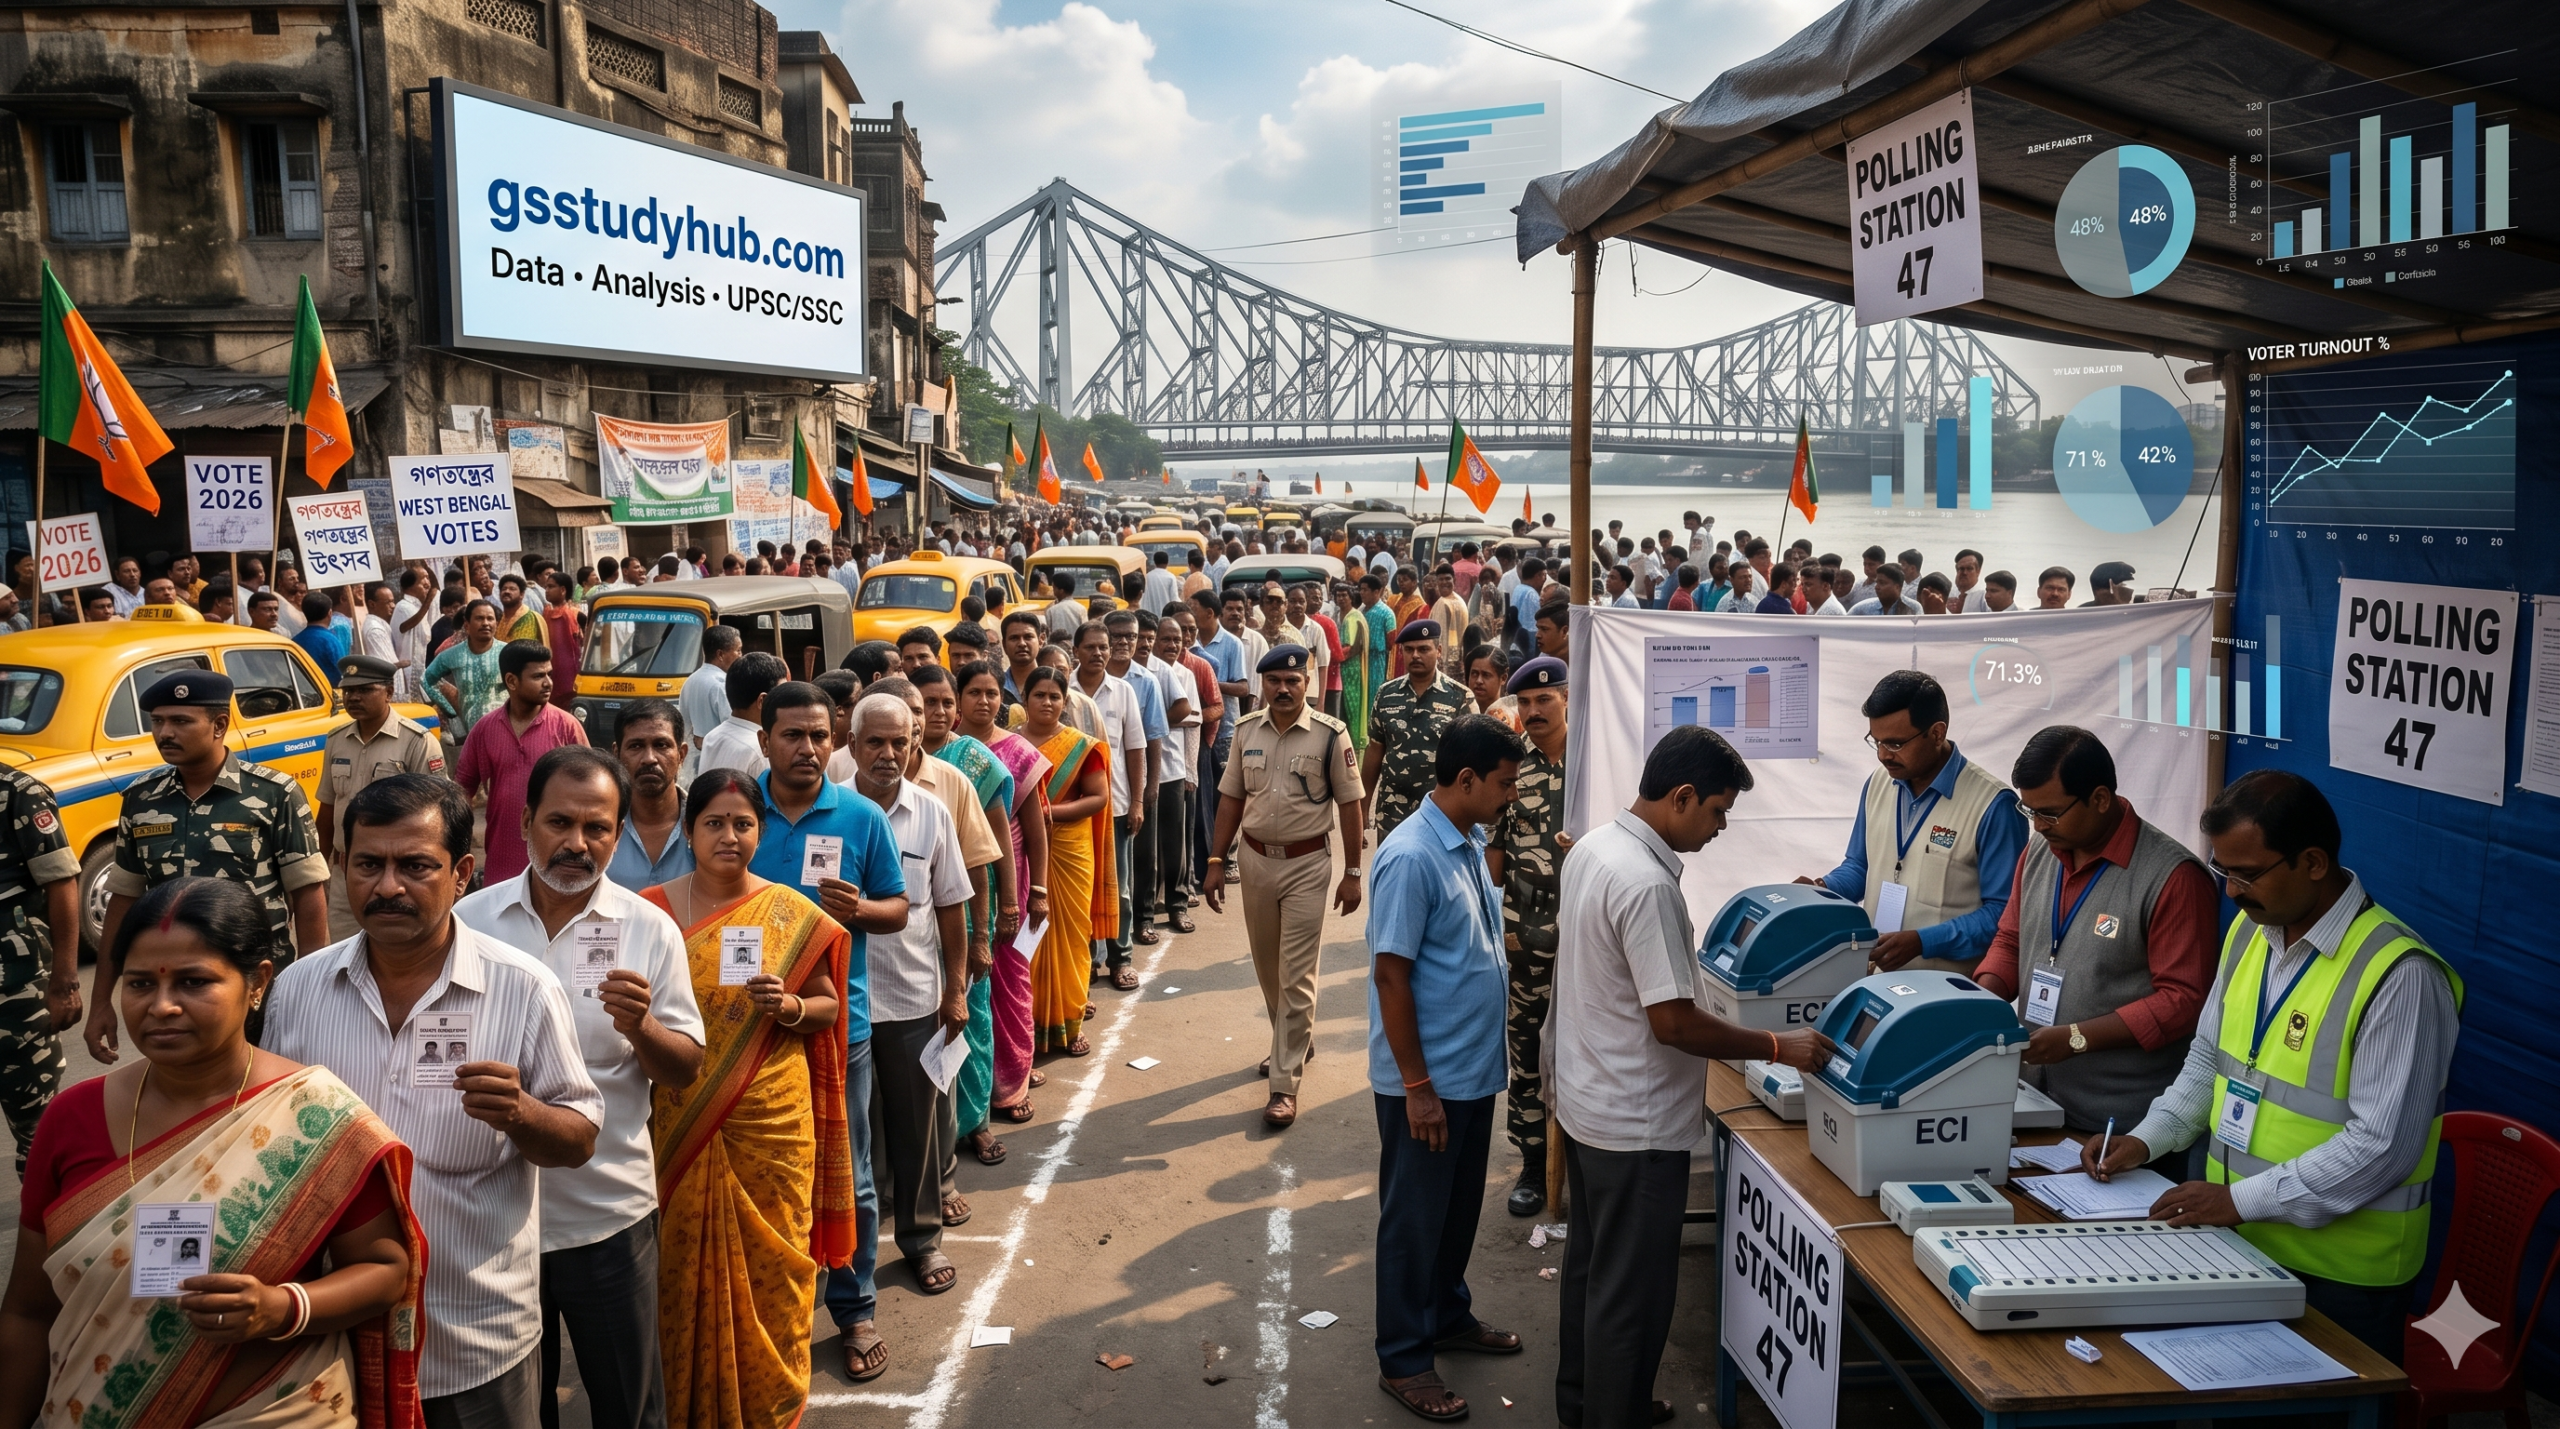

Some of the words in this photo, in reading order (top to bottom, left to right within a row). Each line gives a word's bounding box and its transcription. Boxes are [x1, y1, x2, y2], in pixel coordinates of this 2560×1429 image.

[1856, 120, 1963, 199] POLLING
[488, 178, 844, 279] gsstudyhub.com
[1860, 177, 1965, 249] STATION
[491, 247, 564, 286] Data
[592, 264, 705, 307] Analysis
[728, 284, 843, 325] UPSC/SSC
[1897, 245, 1934, 299] 47
[194, 464, 263, 484] VOTE
[199, 489, 263, 509] 2026
[399, 498, 443, 517] WEST
[449, 494, 511, 513] BENGAL
[423, 519, 499, 545] VOTES
[40, 522, 92, 546] VOTE
[41, 547, 101, 582] 2026
[308, 549, 371, 574] উৎসব
[2349, 597, 2500, 655] POLLING
[2345, 653, 2494, 717] STATION
[2384, 717, 2436, 771] 47
[1916, 1116, 1968, 1145] ECI
[1738, 1172, 1830, 1306] POLLING
[1735, 1231, 1827, 1371] STATION
[1756, 1324, 1793, 1399] 47
